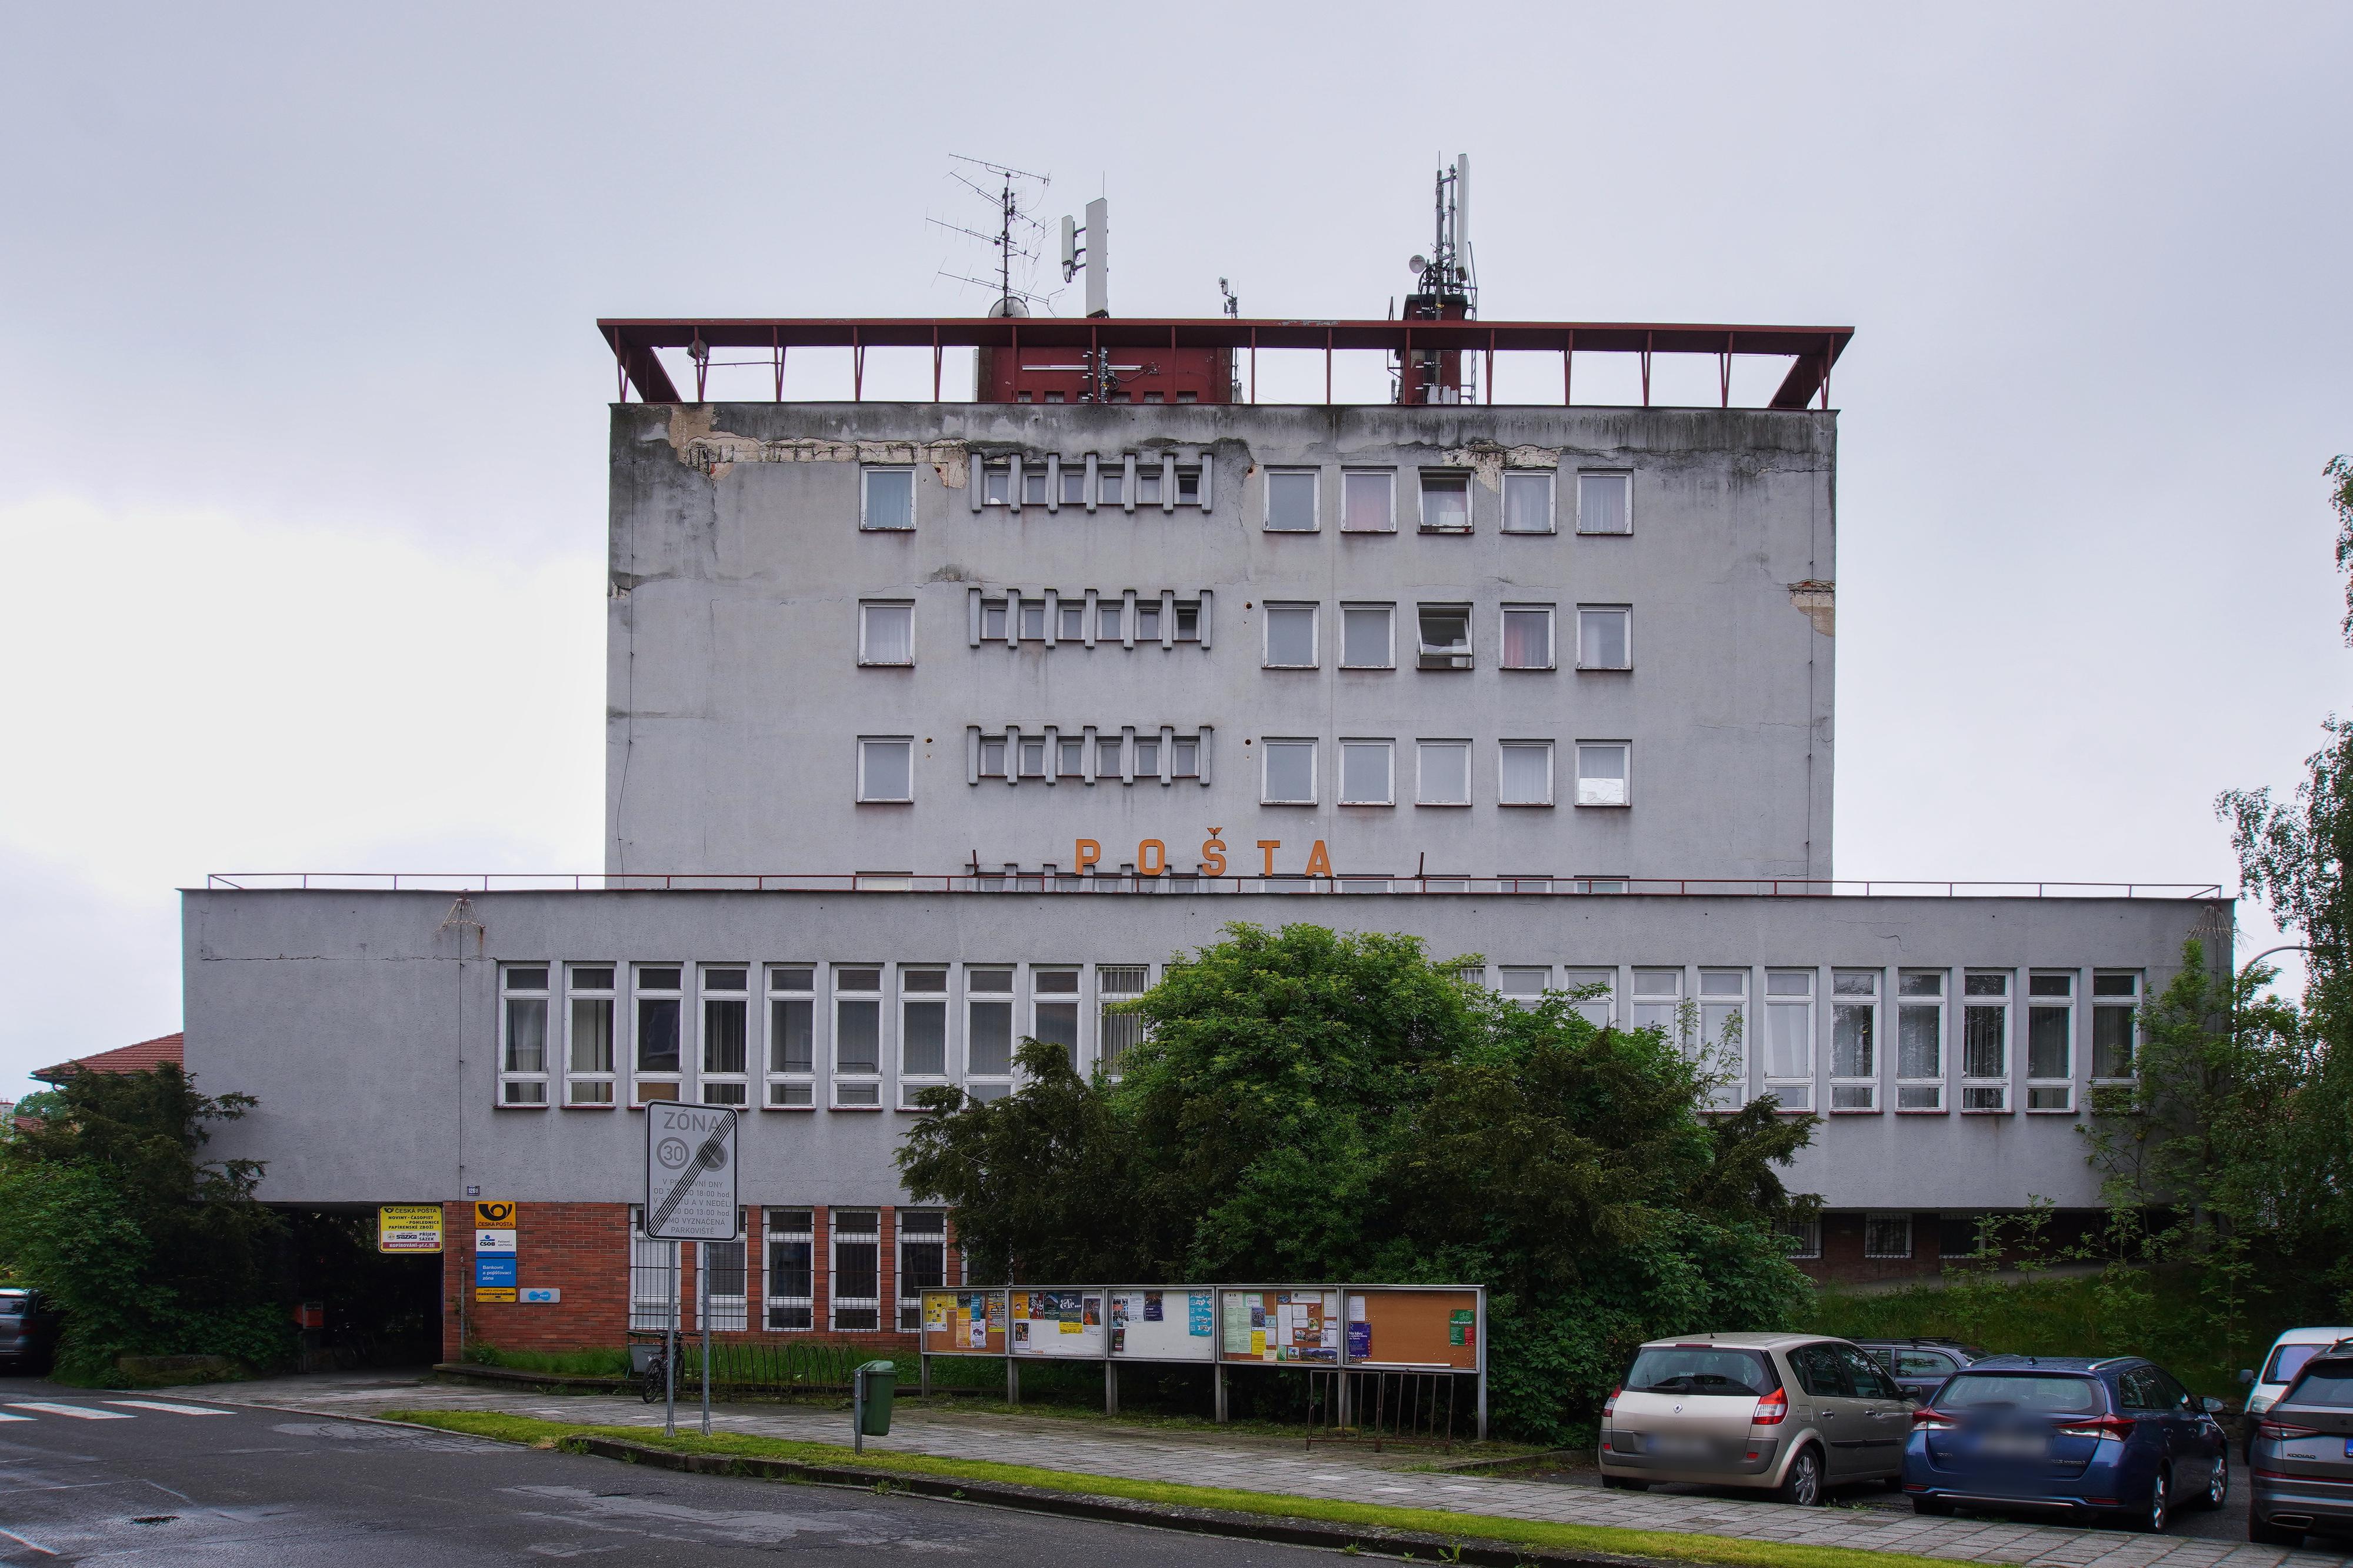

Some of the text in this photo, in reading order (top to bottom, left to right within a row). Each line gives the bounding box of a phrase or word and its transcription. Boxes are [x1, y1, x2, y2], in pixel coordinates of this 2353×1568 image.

[1075, 827, 1332, 876] POŠTA
[664, 1109, 719, 1132] ZÓNA
[664, 1145, 683, 1161] 30
[682, 1217, 725, 1225] VYZNAČENÁ
